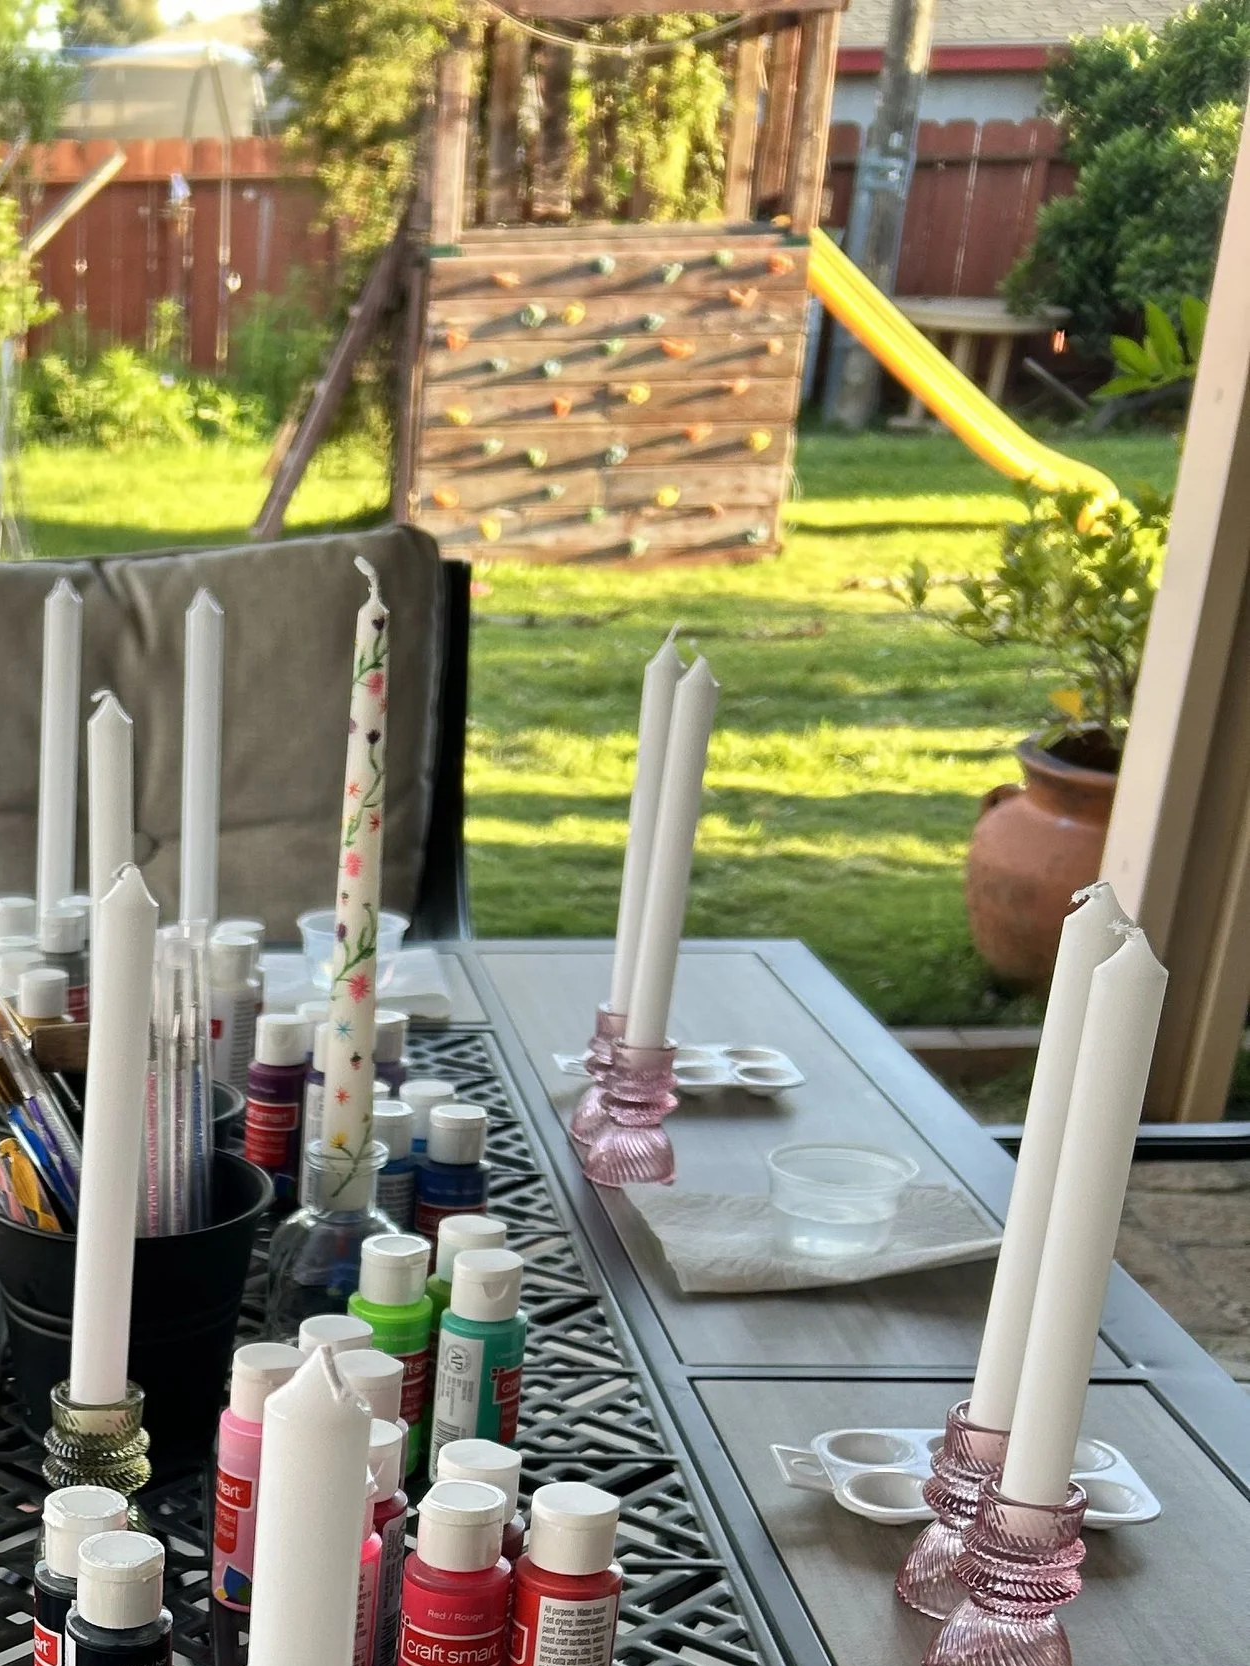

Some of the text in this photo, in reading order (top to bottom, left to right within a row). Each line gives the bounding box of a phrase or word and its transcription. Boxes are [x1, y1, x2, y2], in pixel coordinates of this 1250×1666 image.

[427, 1609, 446, 1620] Red
[454, 1613, 484, 1621] Rouge
[406, 1639, 498, 1664] craft smart
